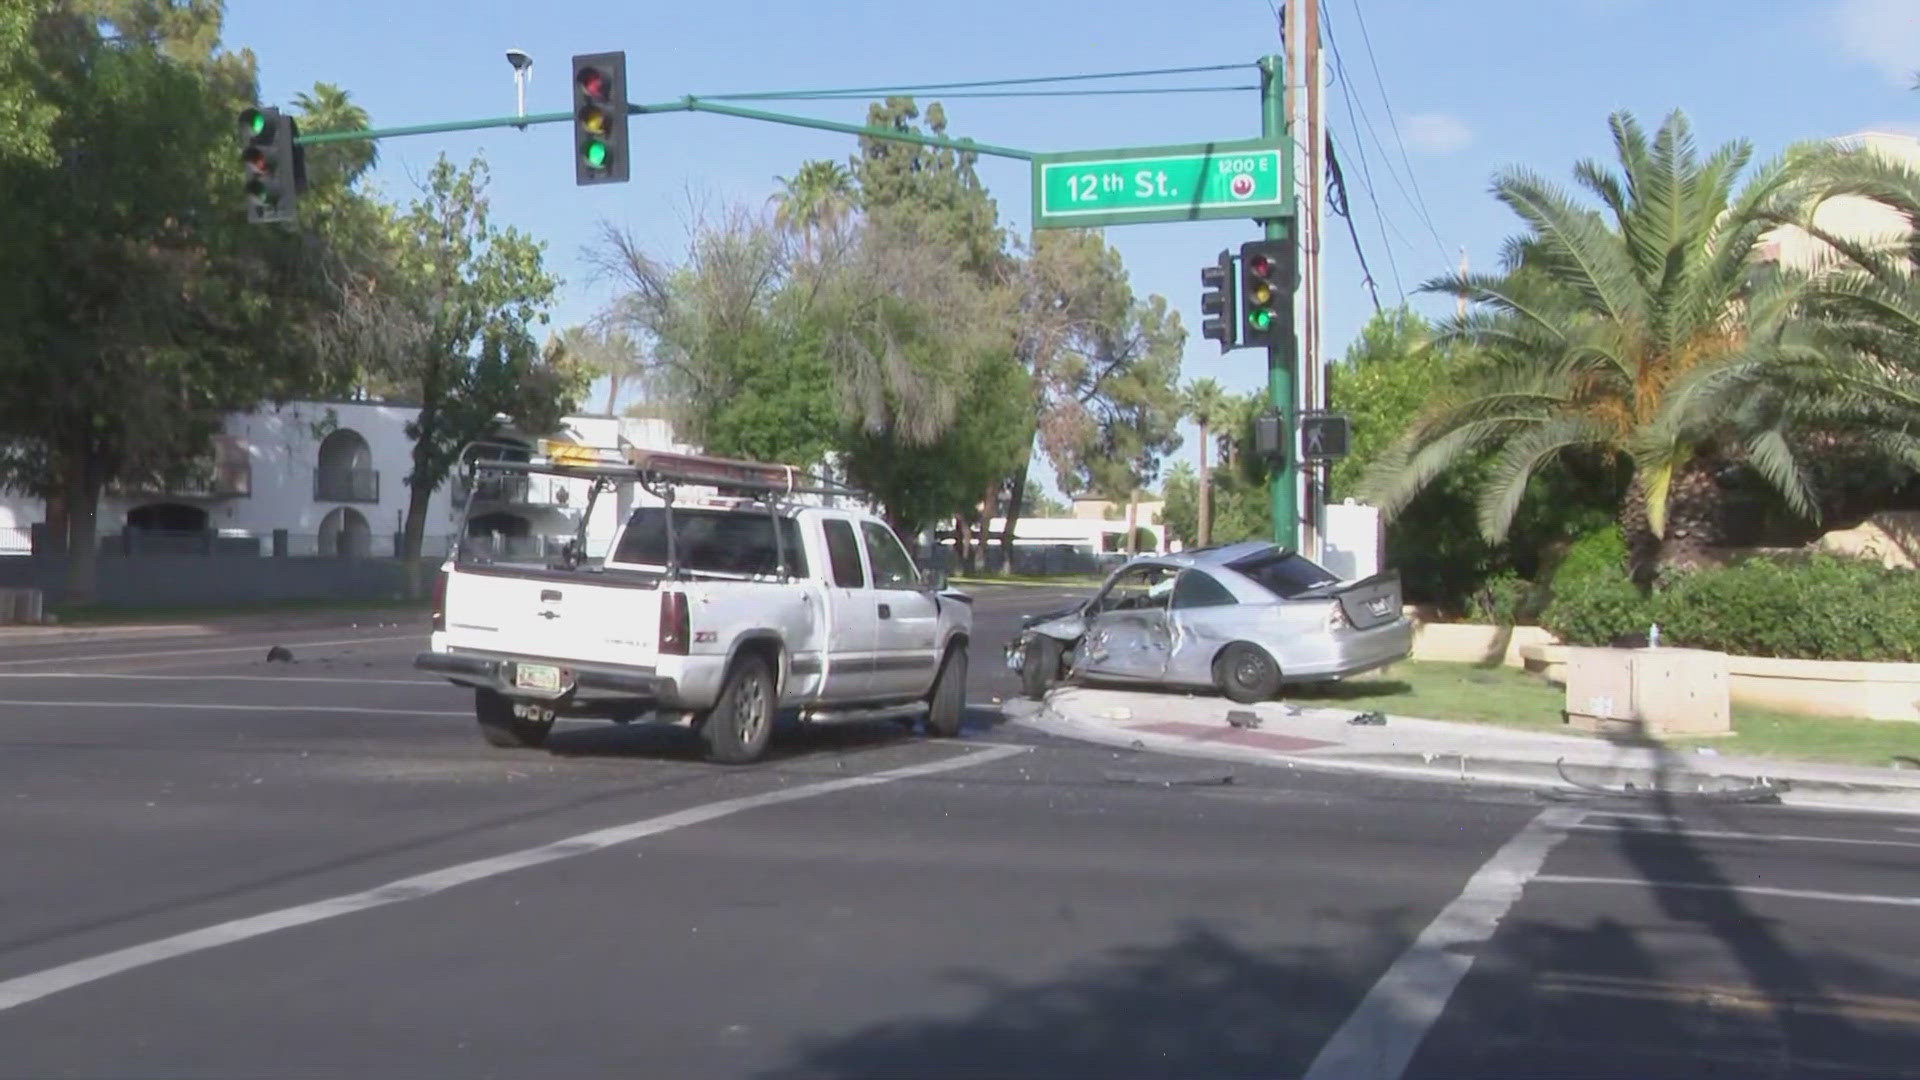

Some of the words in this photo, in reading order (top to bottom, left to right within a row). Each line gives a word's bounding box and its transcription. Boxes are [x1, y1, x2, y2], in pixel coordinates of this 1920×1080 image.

[1219, 159, 1255, 174] 1200
[1259, 158, 1268, 172] E
[1067, 172, 1124, 202] 12th
[1135, 171, 1178, 198] St.
